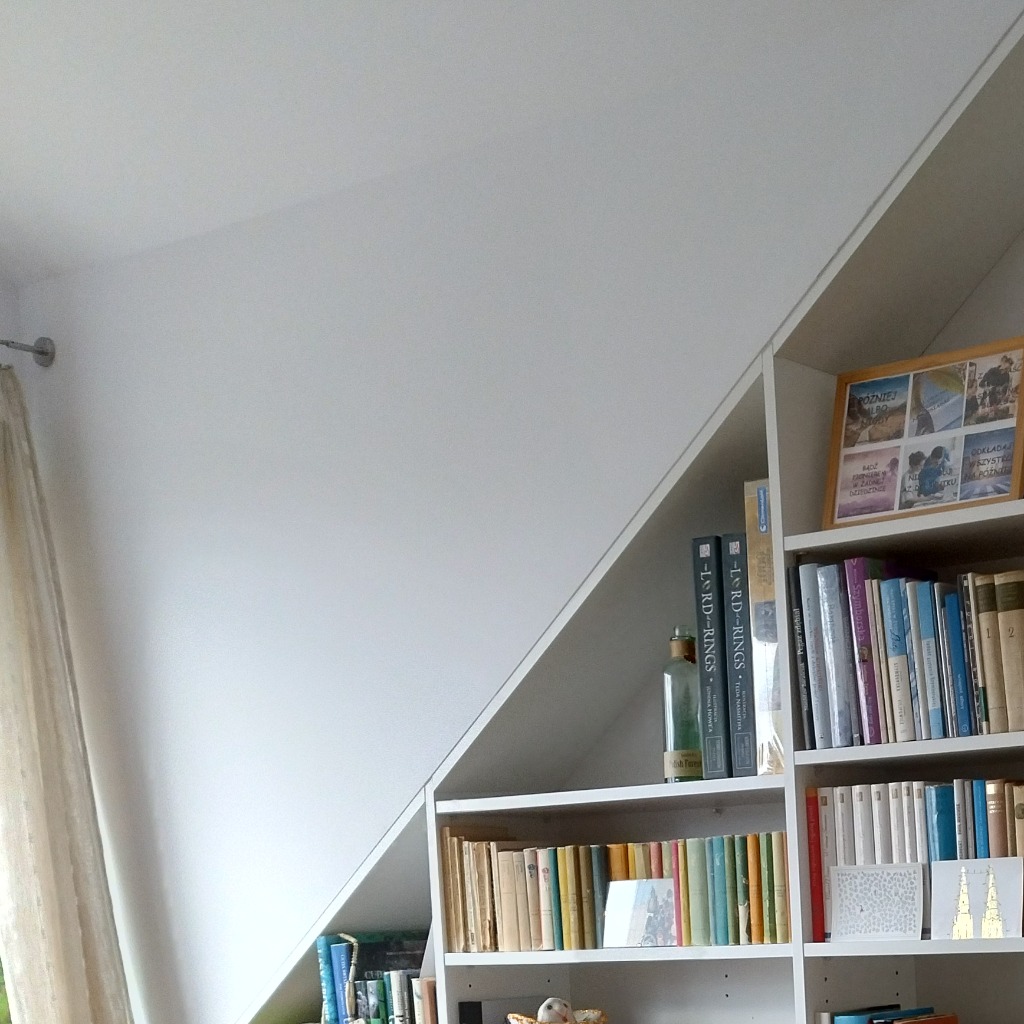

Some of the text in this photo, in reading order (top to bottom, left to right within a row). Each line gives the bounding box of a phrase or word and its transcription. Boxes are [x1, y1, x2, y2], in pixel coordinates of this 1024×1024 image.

[854, 584, 868, 645] Szymborska
[1008, 627, 1015, 638] 2
[703, 627, 717, 673] RINGS
[732, 625, 746, 670] RINGS
